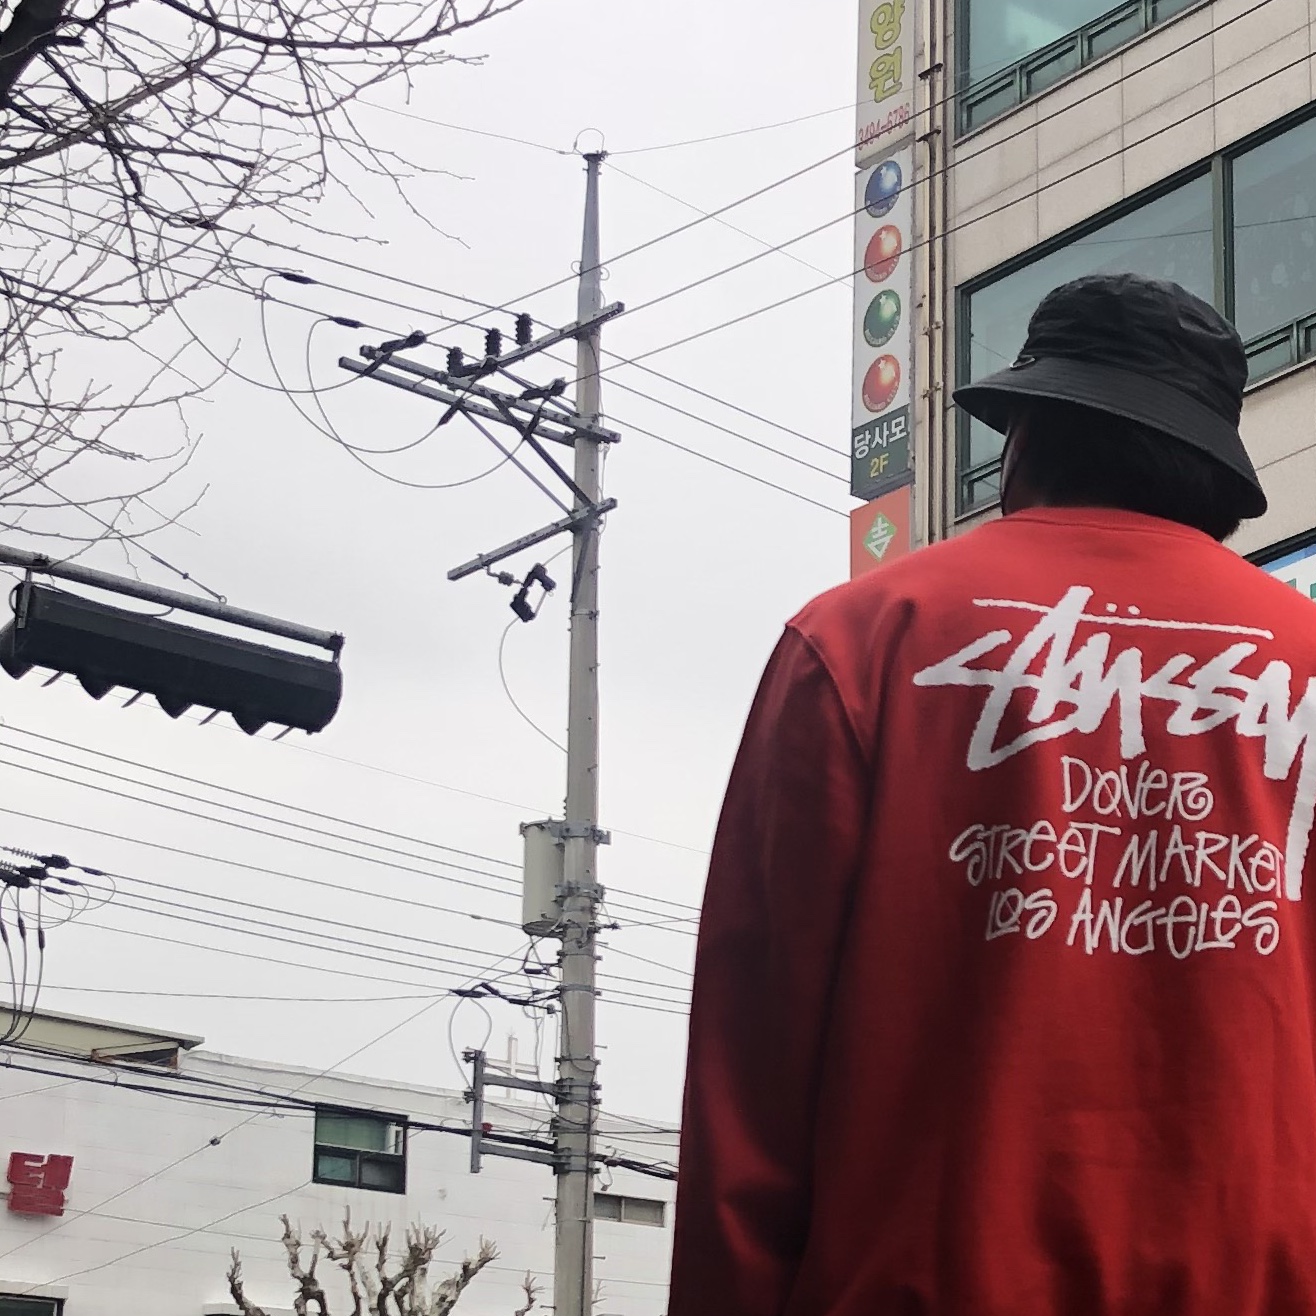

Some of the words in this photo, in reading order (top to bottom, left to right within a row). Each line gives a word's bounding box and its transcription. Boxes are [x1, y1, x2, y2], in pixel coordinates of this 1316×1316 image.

[854, 415, 907, 459] 당사모
[870, 453, 889, 477] 2F
[986, 888, 1058, 941] LOS
[1068, 888, 1280, 960] ANGELES
